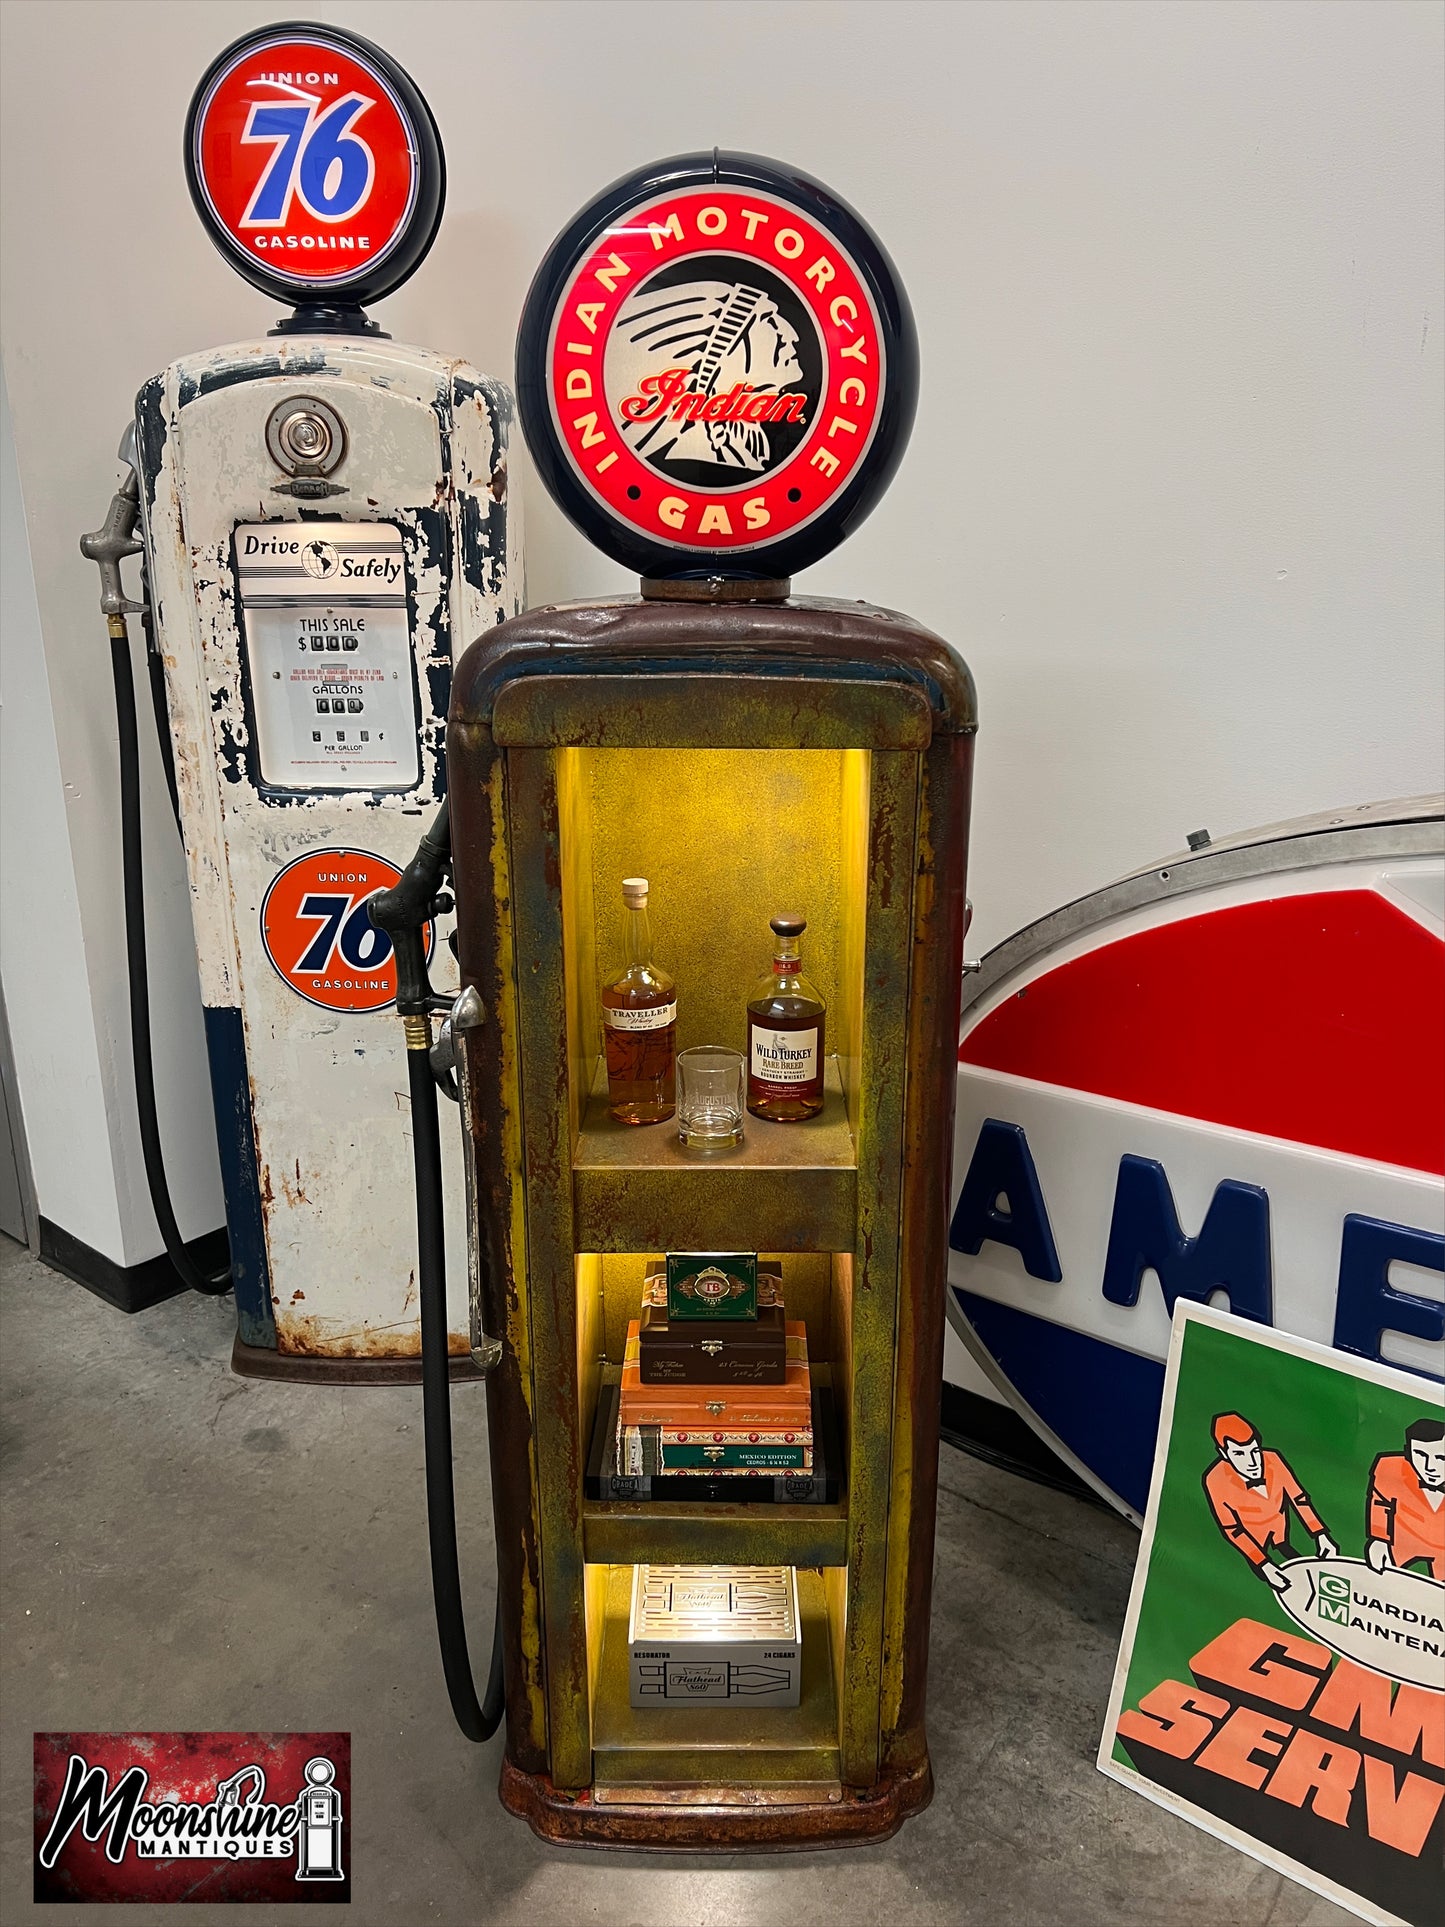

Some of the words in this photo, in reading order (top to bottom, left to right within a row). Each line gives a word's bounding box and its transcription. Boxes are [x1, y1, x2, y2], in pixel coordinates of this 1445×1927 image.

[260, 72, 339, 85] UNION
[238, 91, 377, 228] 76
[254, 235, 370, 249] GASOLINE
[566, 252, 631, 474] INDIAN
[647, 206, 868, 478] MOTORCYCLE
[618, 366, 807, 424] Indian
[657, 496, 771, 535] GAS
[244, 535, 299, 555] Drive
[340, 558, 402, 583] Safely
[300, 618, 329, 632] THIS
[333, 618, 365, 632] SALE
[312, 685, 364, 695] GALLONS
[317, 873, 368, 883] UNION
[290, 886, 395, 974] 76
[312, 979, 390, 990] GASOLINE
[611, 1006, 669, 1018] TRAVELLER
[756, 1042, 778, 1060] WILD
[778, 1047, 812, 1061] TURKEY
[762, 1058, 780, 1069] RARE
[780, 1061, 804, 1070] BREED
[949, 1118, 1445, 1380] AME
[705, 1283, 720, 1292] TB
[672, 1675, 722, 1684] Flathead
[1116, 1679, 1445, 1858] SERV
